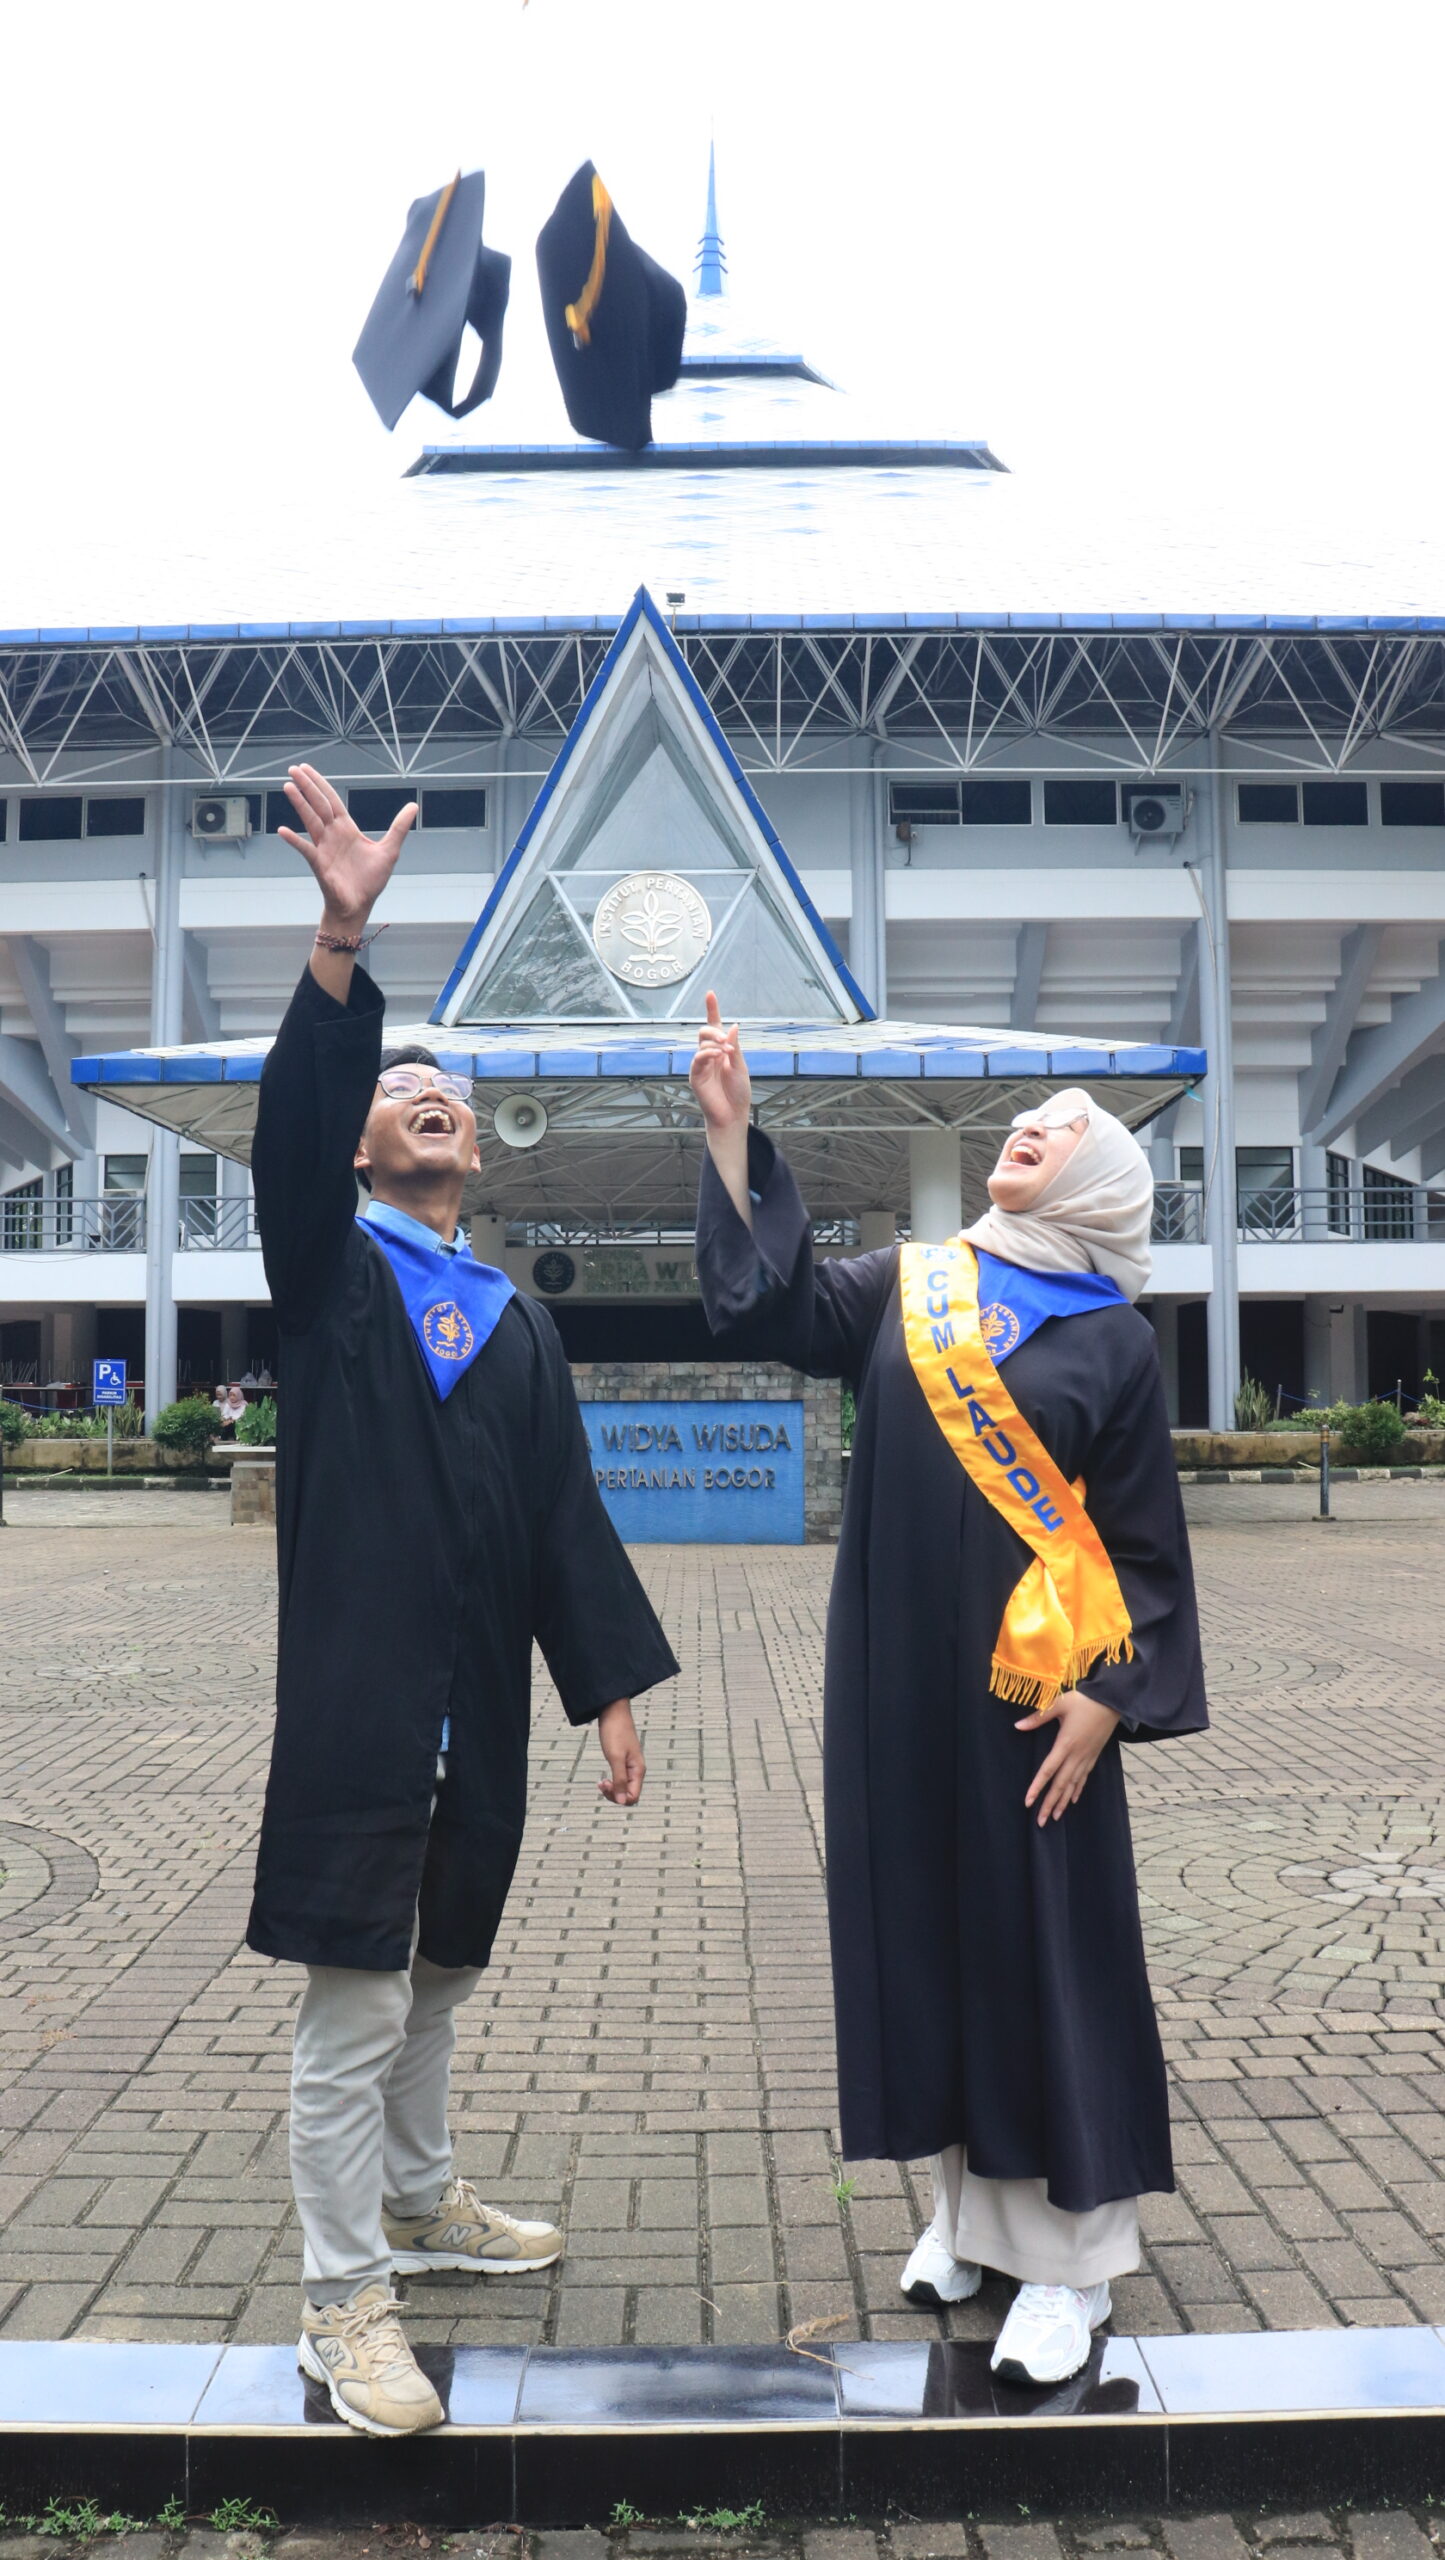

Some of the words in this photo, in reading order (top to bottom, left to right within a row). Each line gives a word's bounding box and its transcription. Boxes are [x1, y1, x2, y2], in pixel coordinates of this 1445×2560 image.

[599, 881, 637, 938] INSTITUT
[646, 877, 704, 939] PERTANIAN
[620, 960, 683, 980] BOGOR
[99, 1363, 111, 1380] P
[926, 1270, 956, 1354] CUM
[945, 1366, 1066, 1533] LAUDE
[601, 1423, 683, 1452] WIDYA
[691, 1423, 792, 1452] WISUDA
[595, 1467, 696, 1490] PERTANIAN
[703, 1466, 776, 1490] BOGOR
